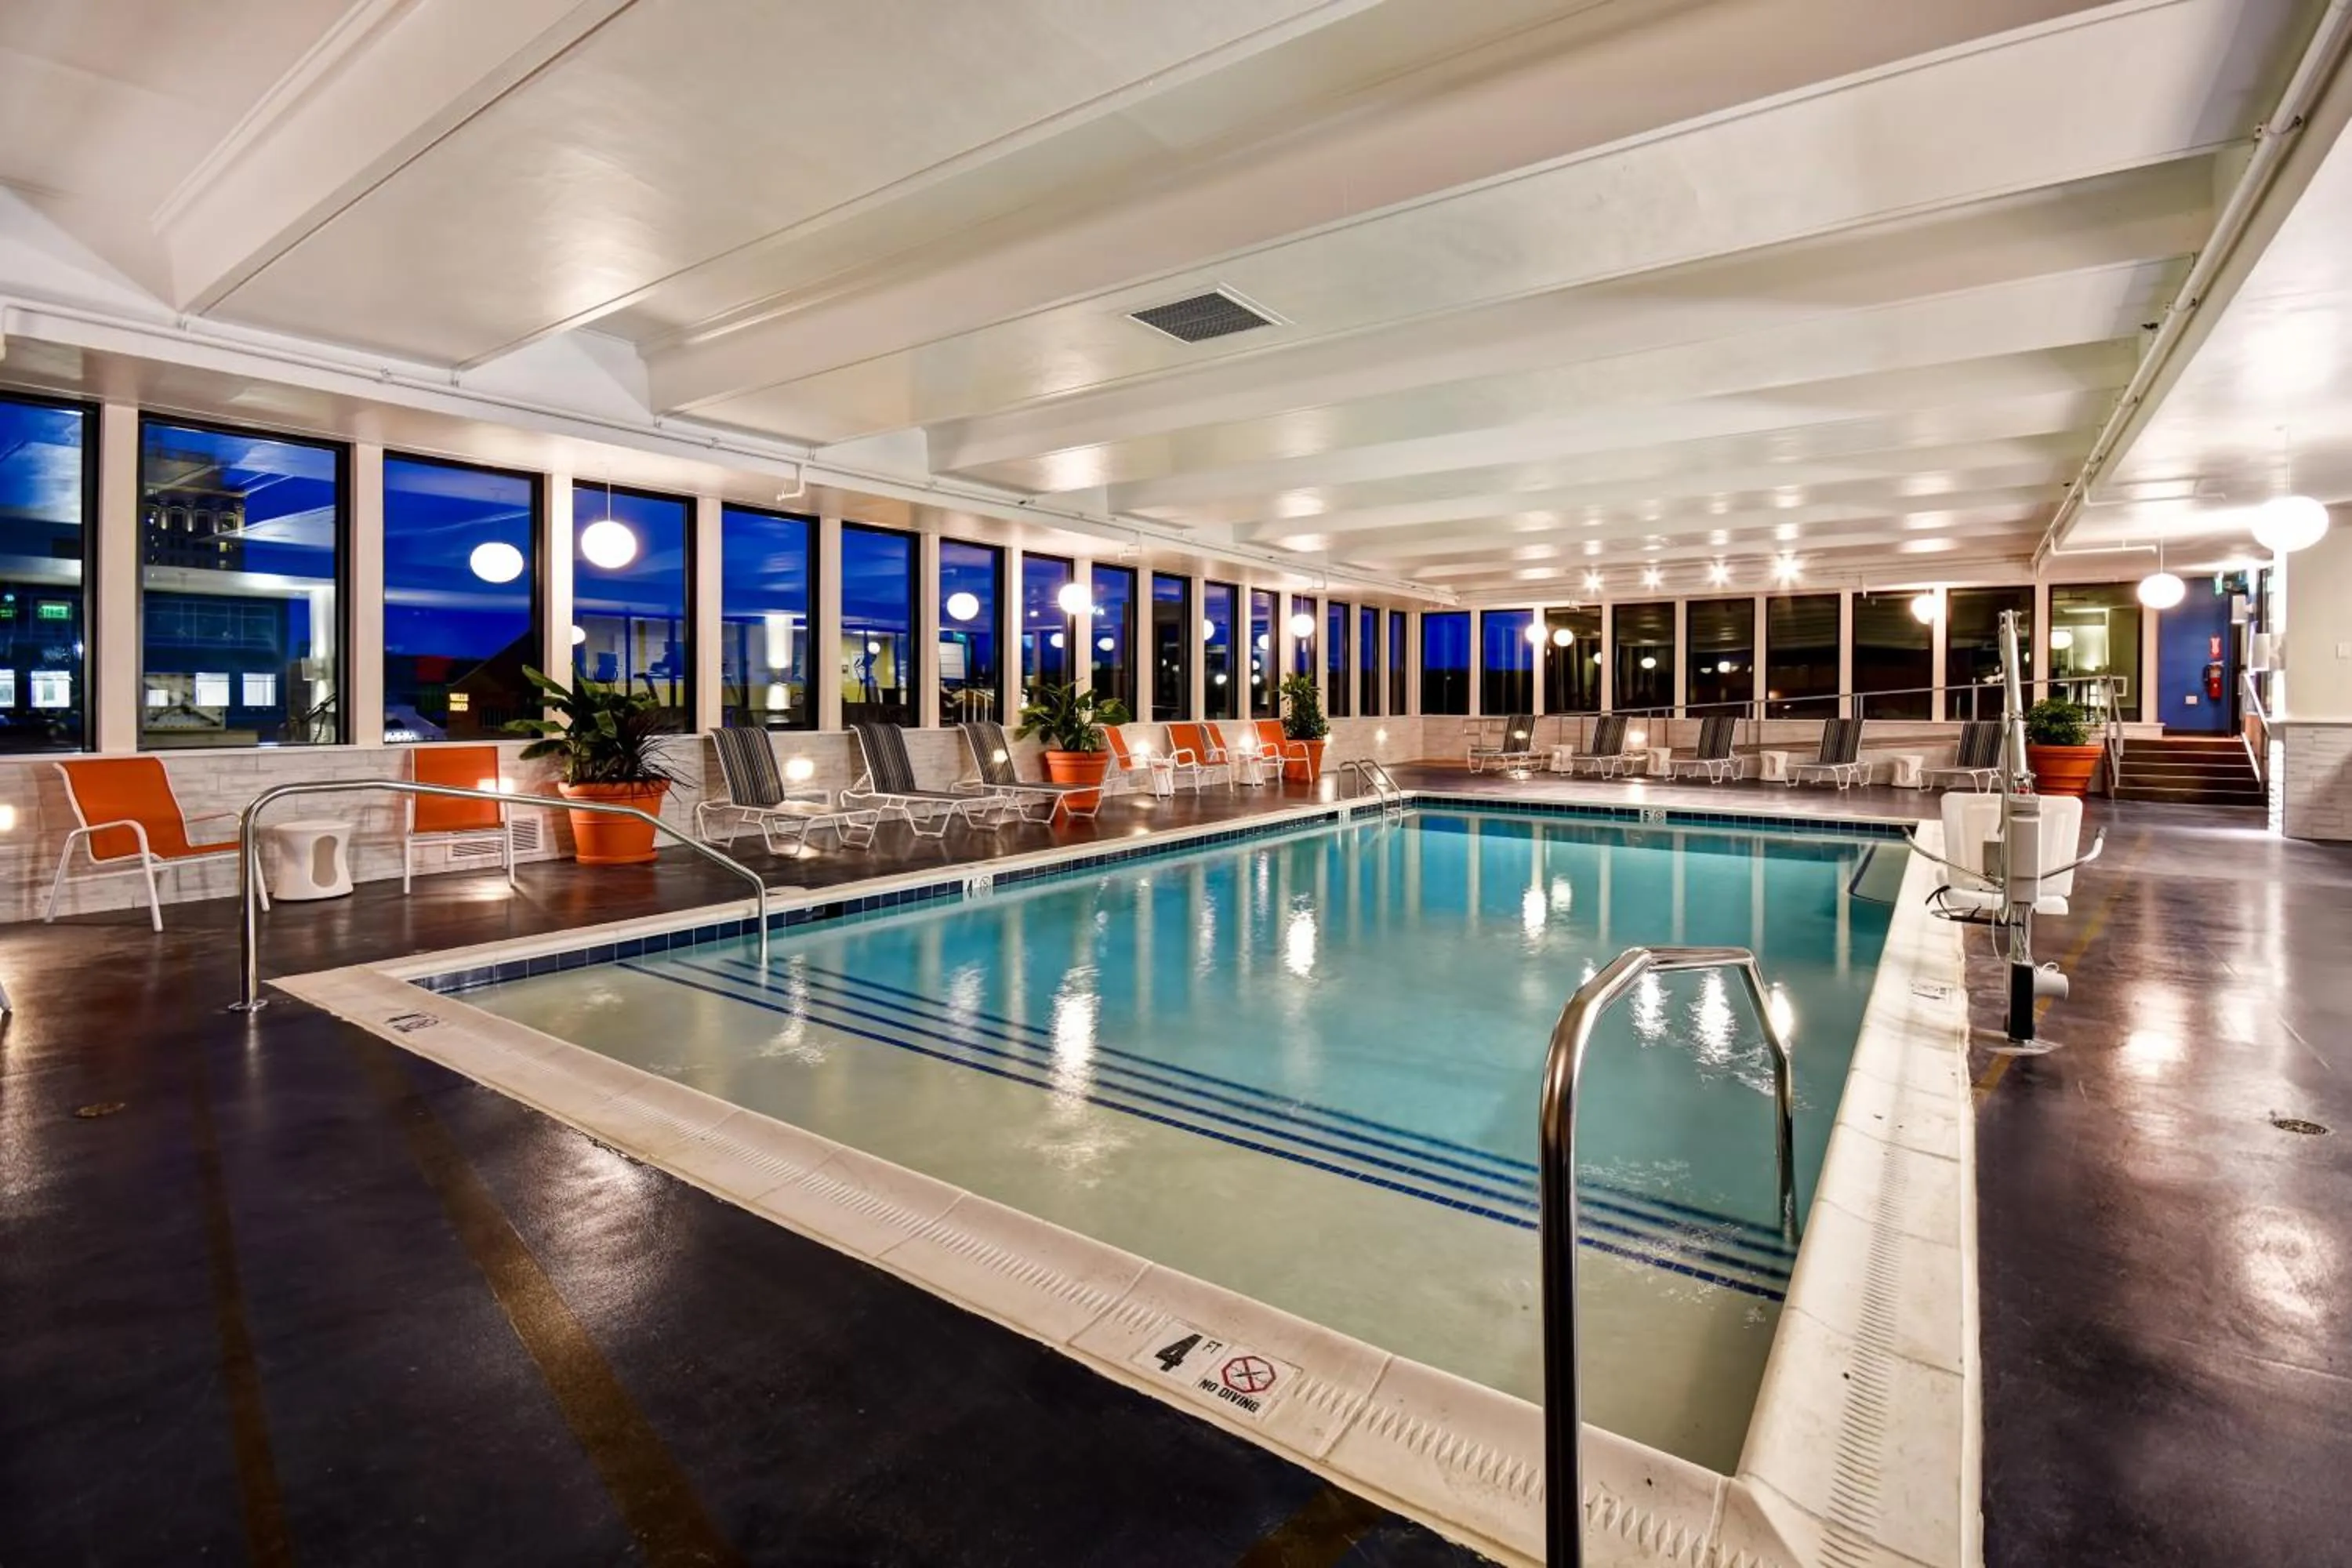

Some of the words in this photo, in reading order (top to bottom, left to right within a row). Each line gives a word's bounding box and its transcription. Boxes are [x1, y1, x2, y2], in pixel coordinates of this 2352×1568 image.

[1154, 1334, 1203, 1372] 4
[1202, 1341, 1223, 1354] FT
[1198, 1379, 1218, 1392] NO
[1218, 1388, 1261, 1413] DIVING
